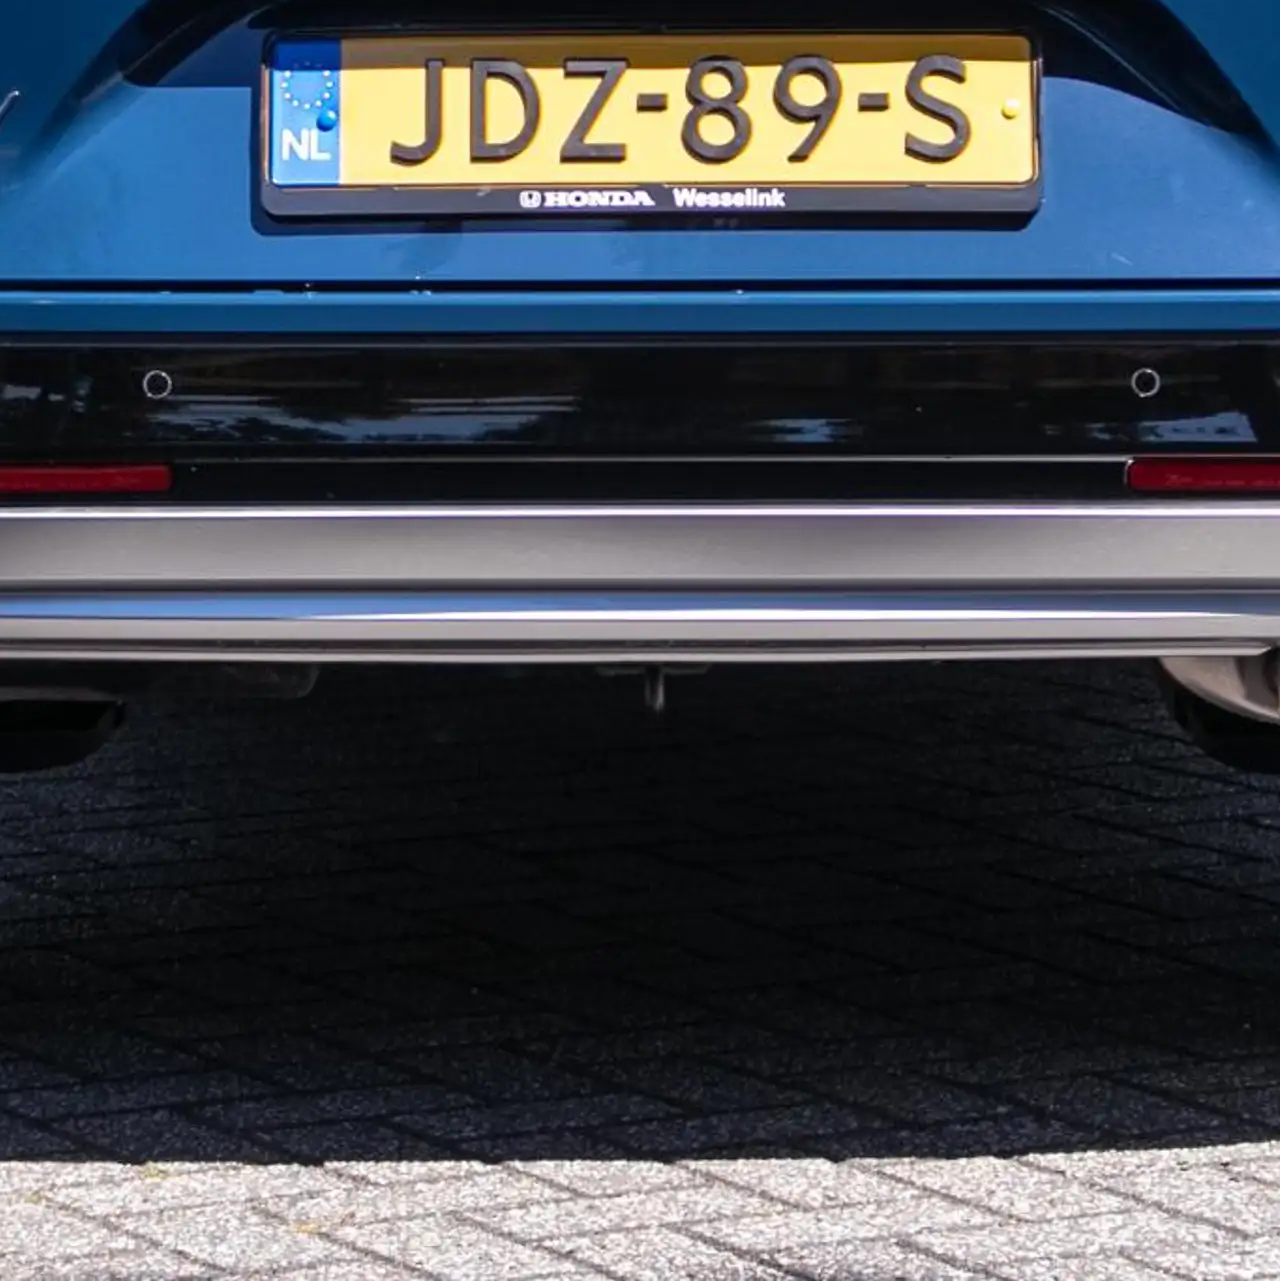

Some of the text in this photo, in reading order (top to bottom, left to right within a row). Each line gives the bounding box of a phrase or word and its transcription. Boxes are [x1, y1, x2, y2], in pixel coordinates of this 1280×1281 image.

[389, 55, 972, 166] JDZ-89-S
[281, 128, 332, 161] NL
[543, 188, 786, 208] HONDA Wesselink
